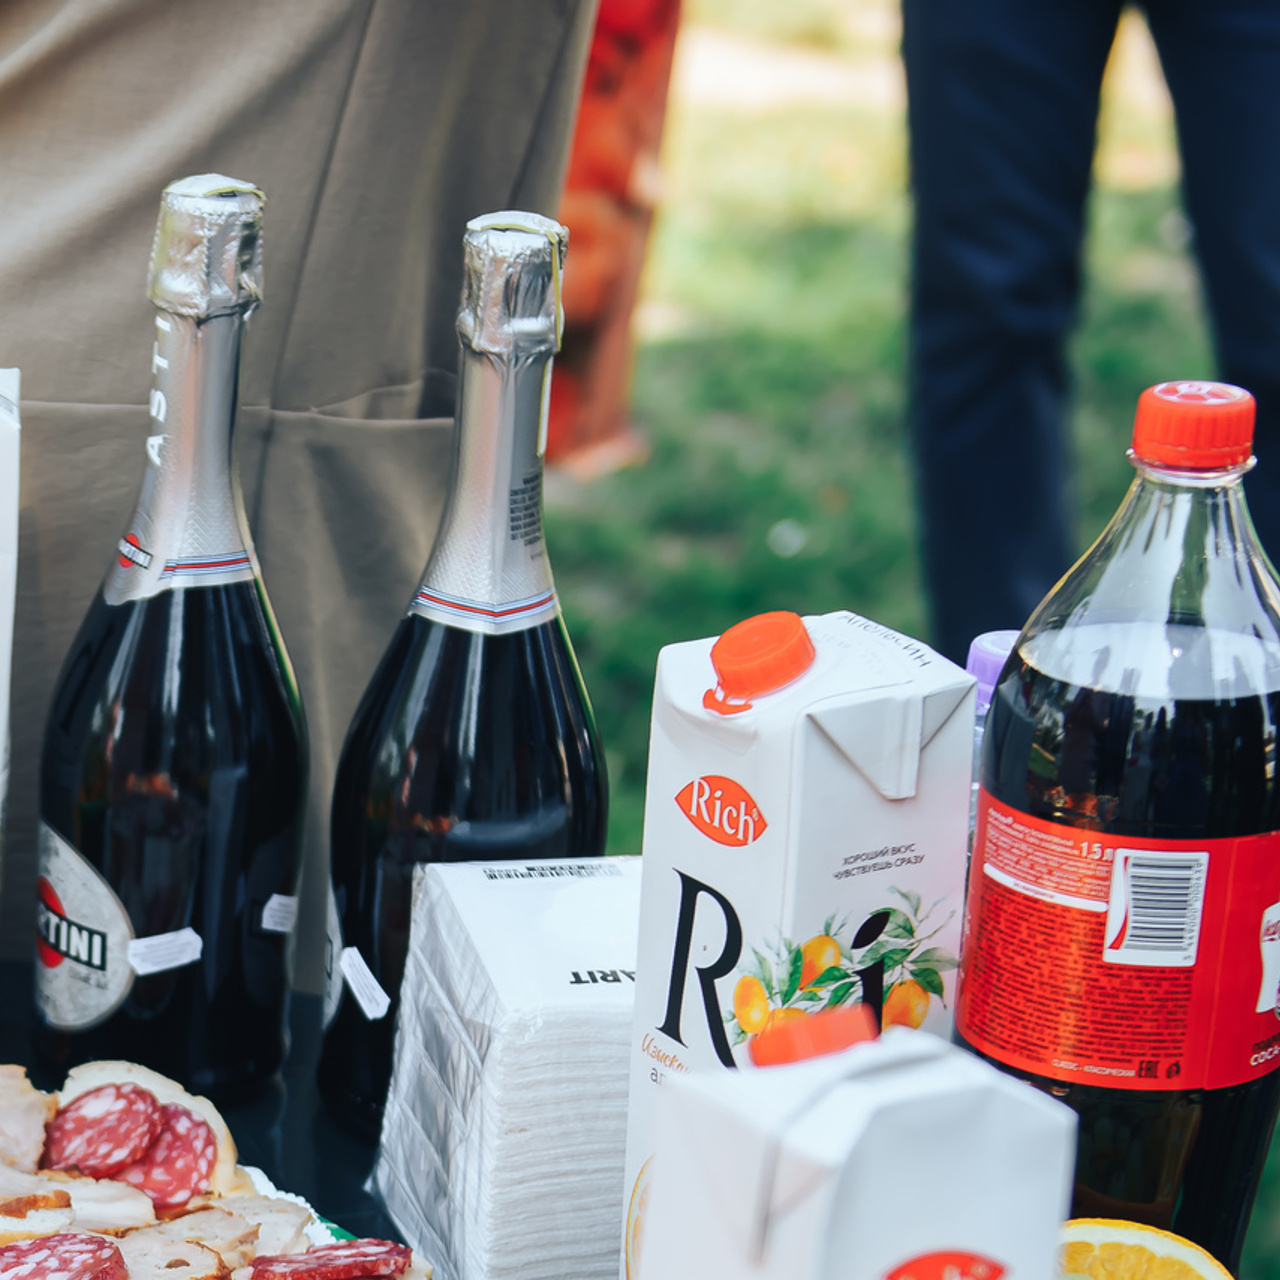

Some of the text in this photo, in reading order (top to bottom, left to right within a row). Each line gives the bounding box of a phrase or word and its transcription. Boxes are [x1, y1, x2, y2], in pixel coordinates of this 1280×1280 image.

[146, 315, 171, 468] ASTI
[842, 842, 916, 866] ХОРОШИЙ ВКУС
[893, 854, 925, 868] СРАЗУ
[654, 867, 743, 1072] R
